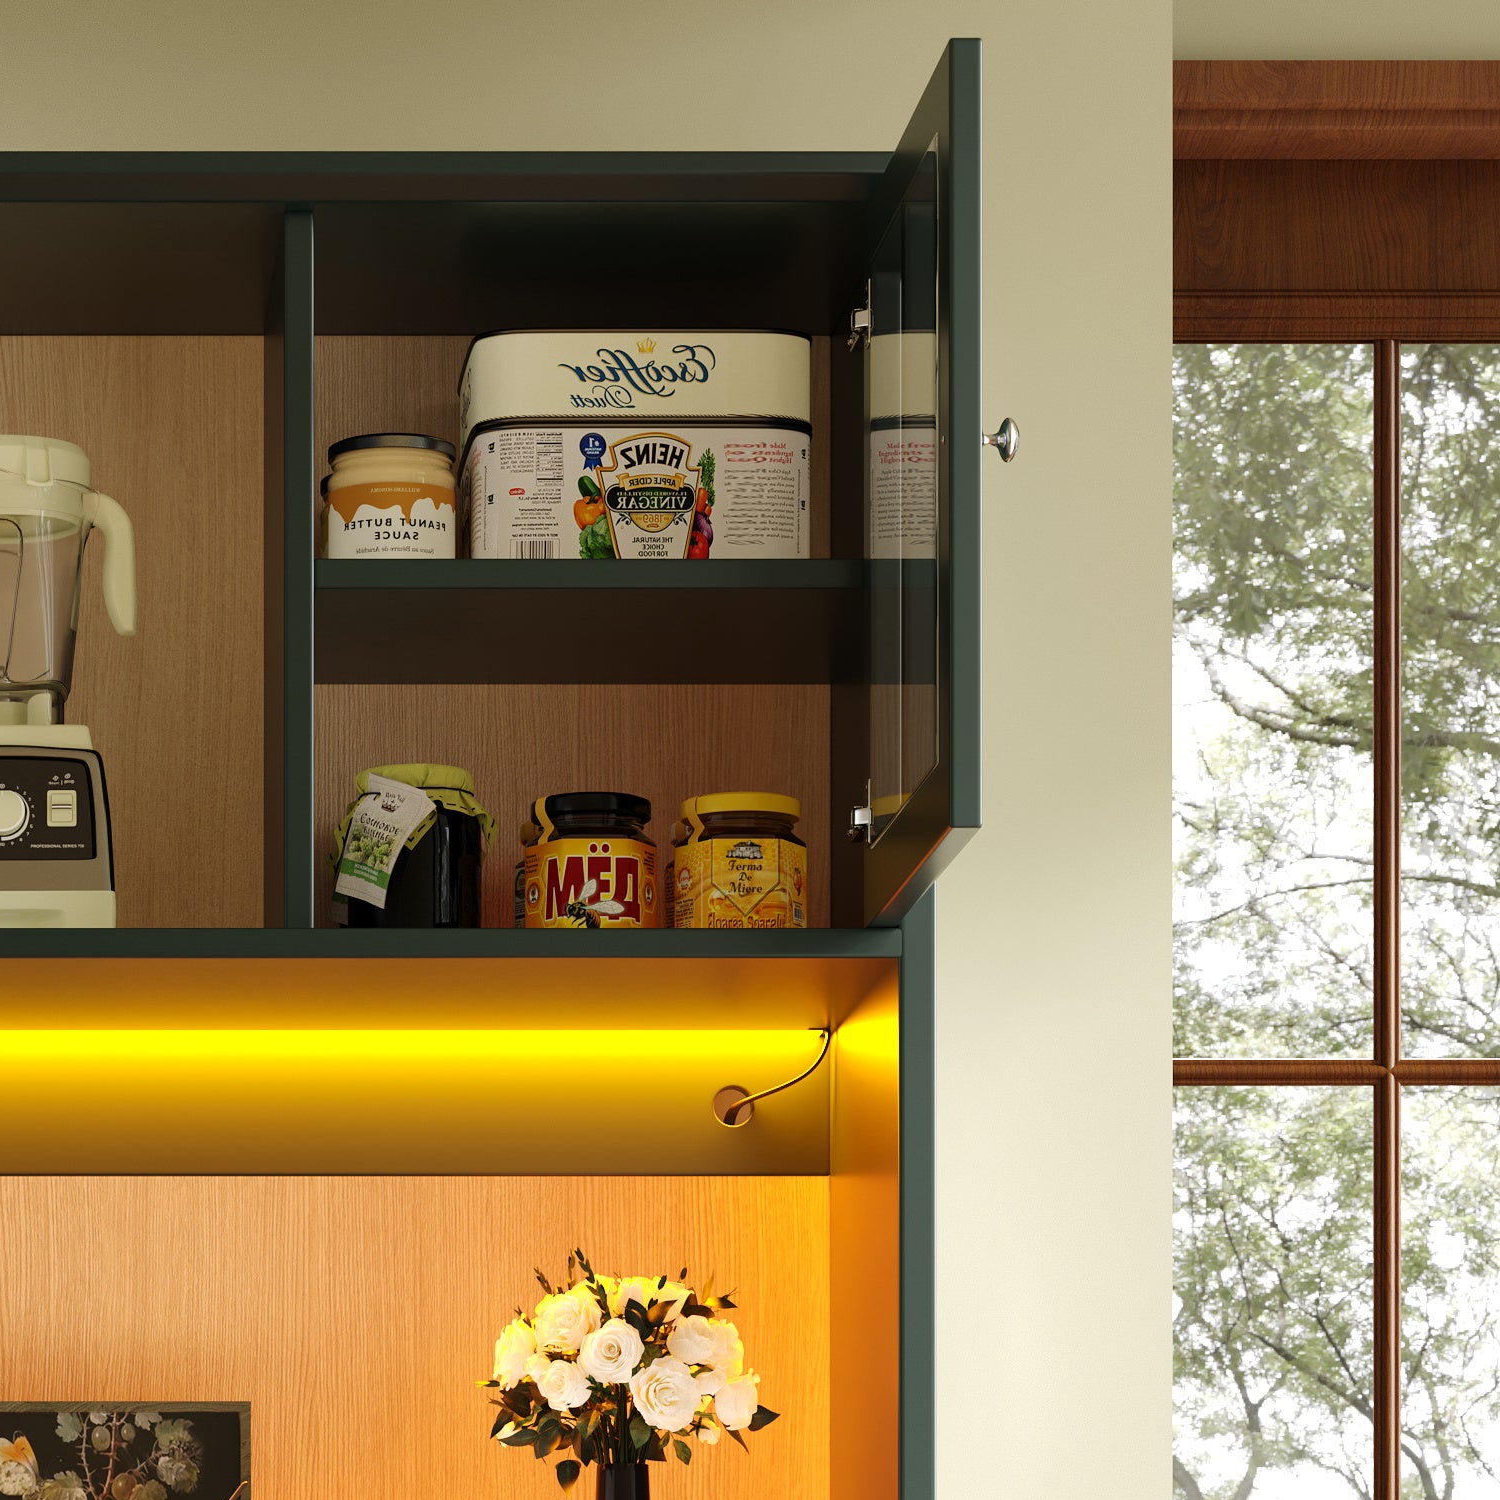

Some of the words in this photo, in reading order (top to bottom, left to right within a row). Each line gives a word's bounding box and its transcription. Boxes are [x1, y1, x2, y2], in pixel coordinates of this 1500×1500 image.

[728, 860, 763, 871] Ferma
[738, 871, 752, 881] De
[545, 843, 641, 924] МЁД
[728, 882, 763, 893] Miere
